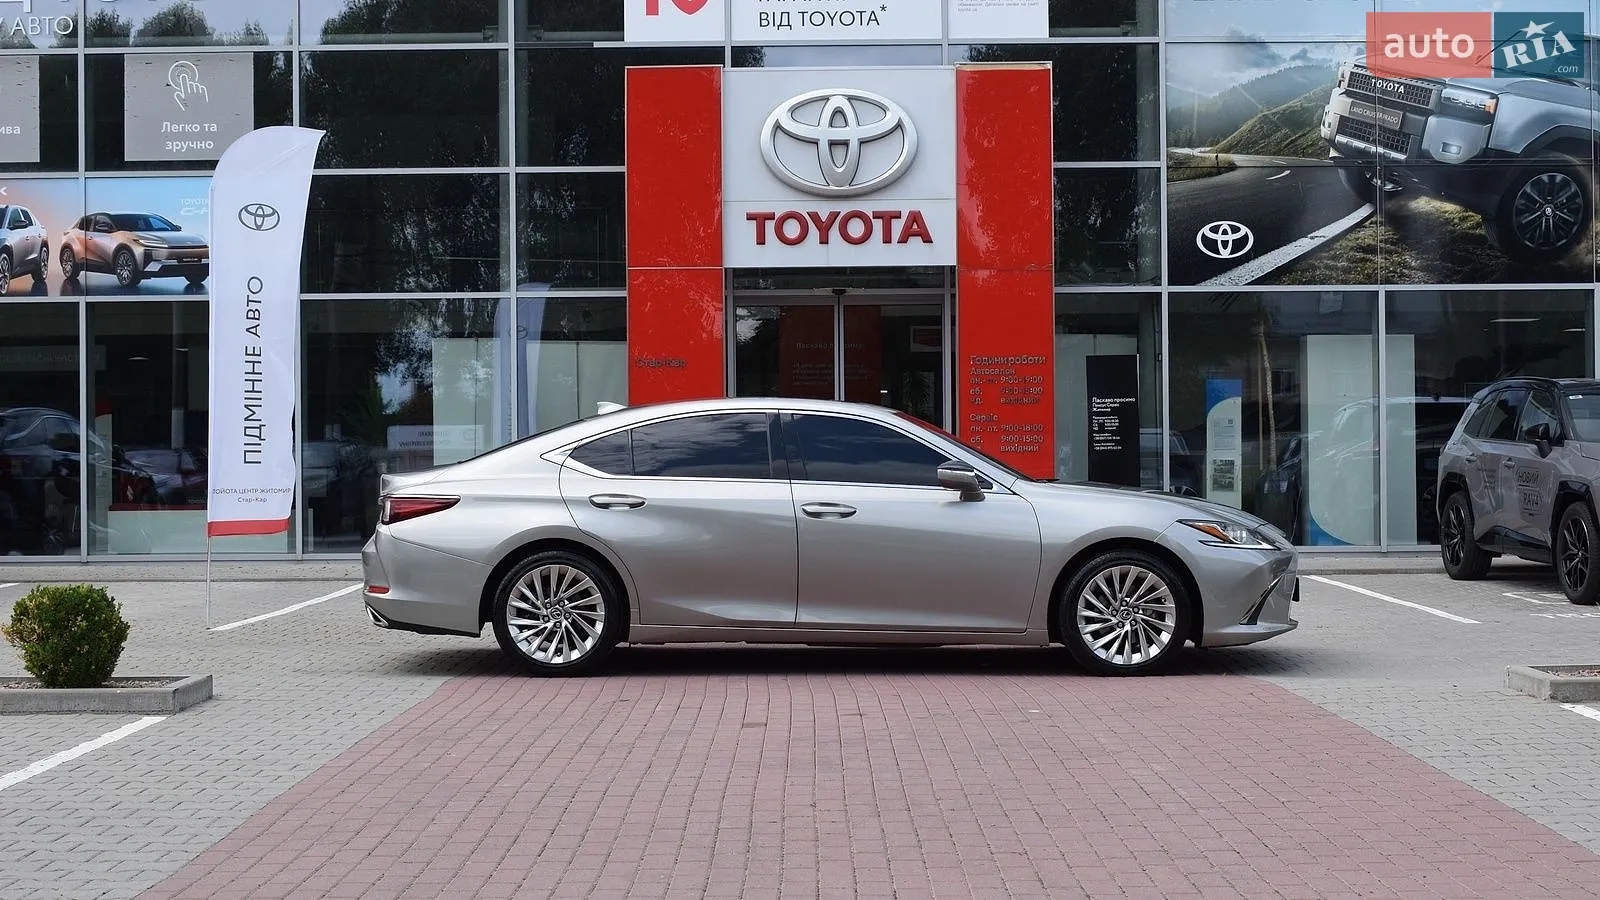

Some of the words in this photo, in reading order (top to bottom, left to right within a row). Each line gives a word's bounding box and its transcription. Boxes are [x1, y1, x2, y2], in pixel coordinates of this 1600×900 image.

[10, 16, 73, 35] АВТО
[759, 11, 793, 30] ВІД
[1371, 79, 1405, 94] TOYOTA
[161, 121, 200, 134] Легко
[204, 122, 217, 132] та
[165, 140, 214, 152] зручно
[746, 210, 933, 246] TOYOTA
[245, 276, 264, 338] АВТО
[970, 355, 1007, 365] Години
[1008, 354, 1046, 366] роботи
[243, 345, 266, 464] ПІДМІННЕ
[970, 435, 983, 443] сб.
